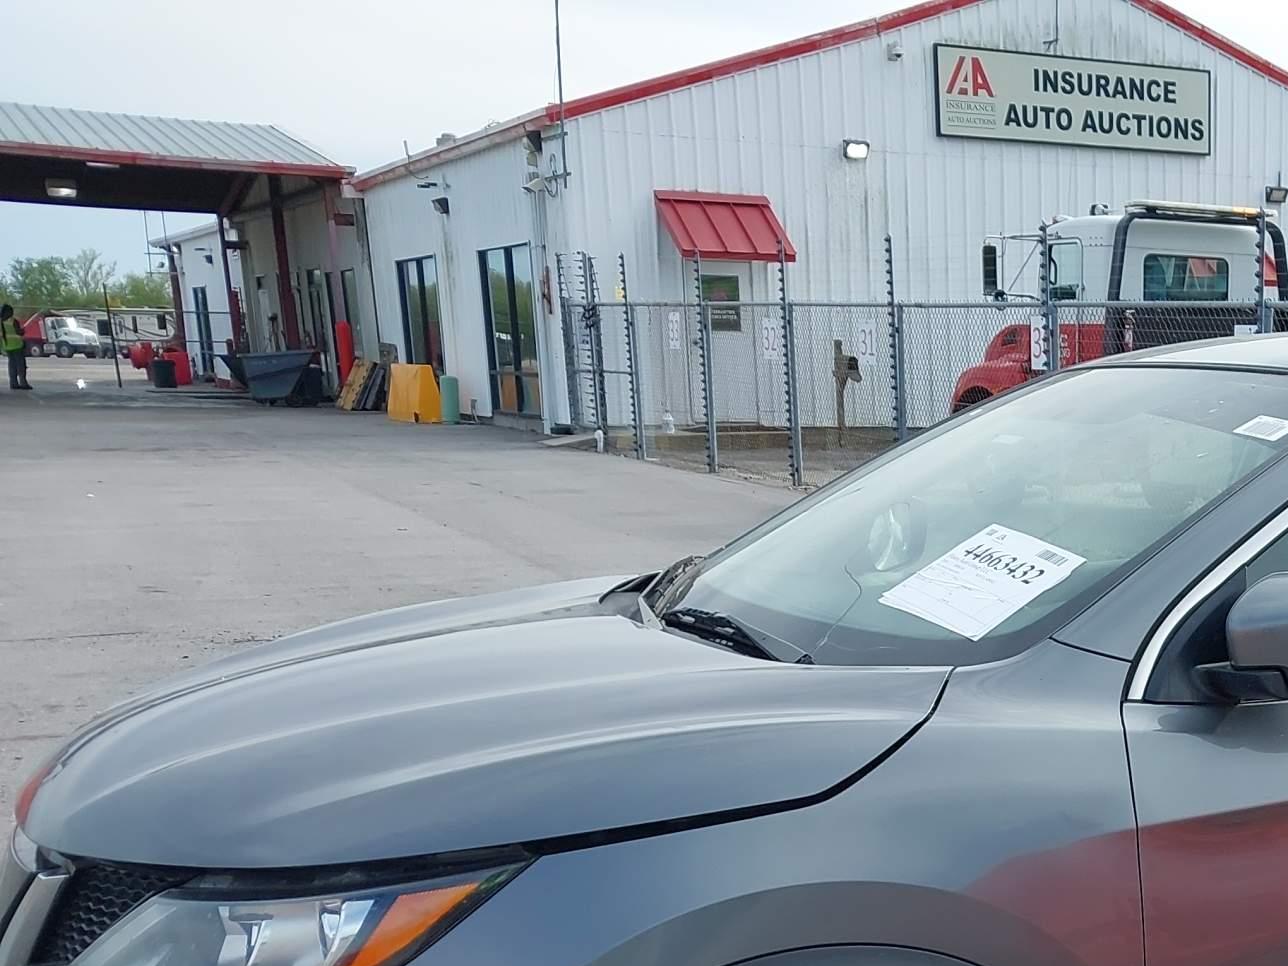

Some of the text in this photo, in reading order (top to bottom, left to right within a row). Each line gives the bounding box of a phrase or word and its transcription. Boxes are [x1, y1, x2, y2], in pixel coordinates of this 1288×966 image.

[1032, 68, 1177, 104] INSURANCE
[945, 100, 996, 113] INSURANCE
[947, 115, 997, 126] AUTO AUCTIONS
[1004, 103, 1205, 142] AUTO AUCTIONS
[763, 326, 777, 351] 32
[860, 328, 876, 357] 31
[963, 543, 1046, 585] 44663432
